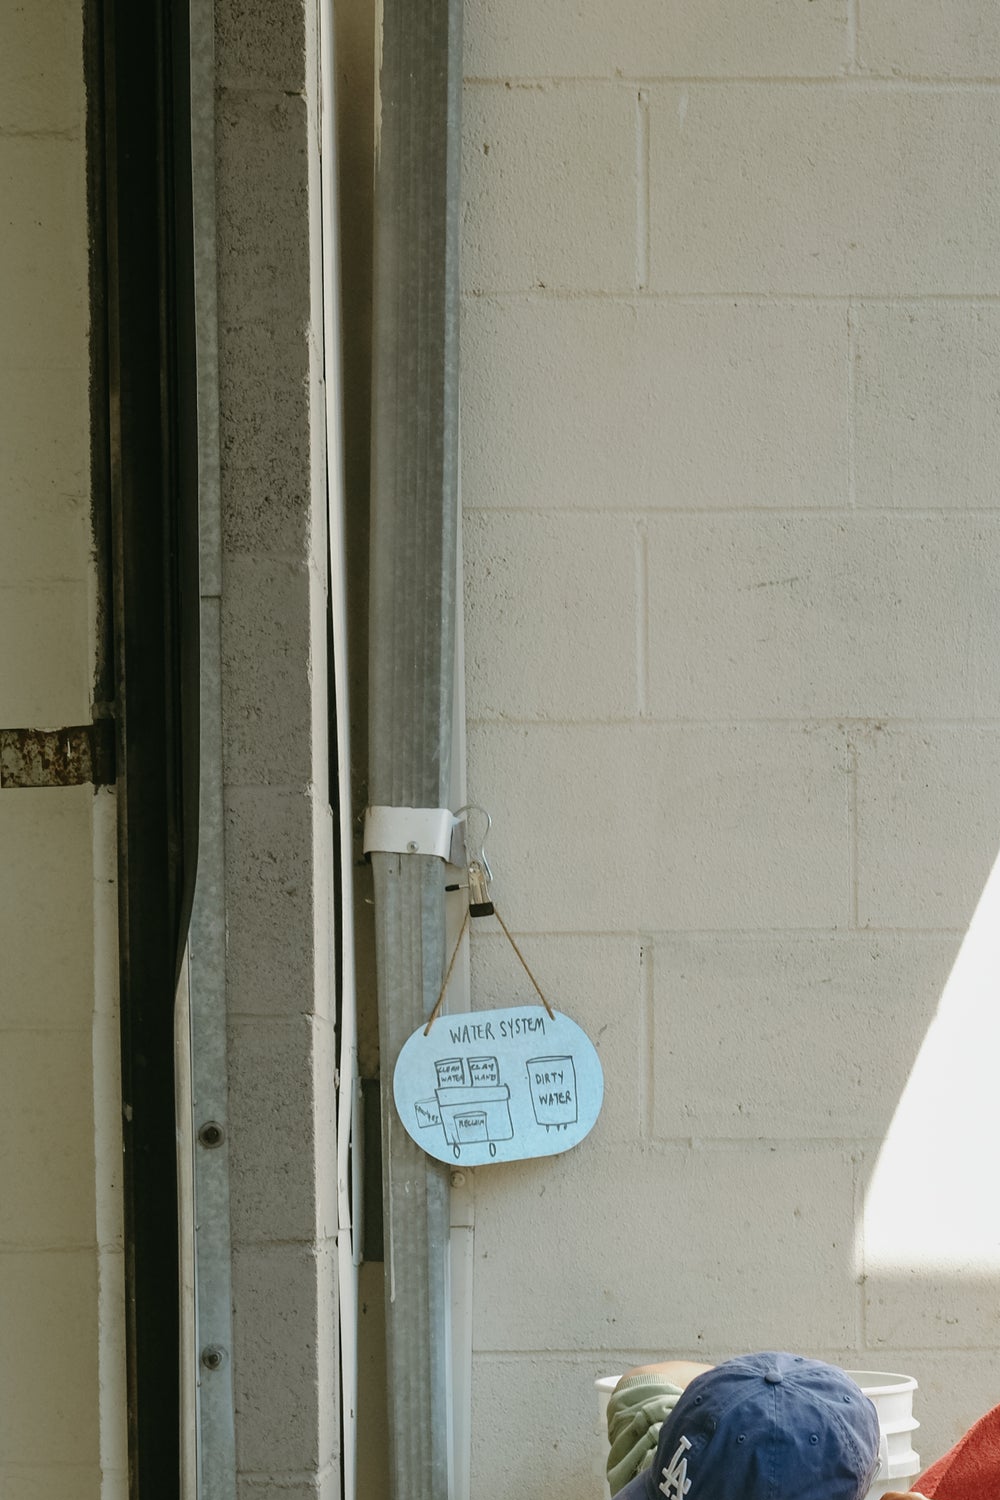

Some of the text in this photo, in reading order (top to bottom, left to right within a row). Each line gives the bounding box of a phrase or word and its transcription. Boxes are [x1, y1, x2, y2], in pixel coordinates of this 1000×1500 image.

[450, 1017, 545, 1044] WATER SYSTEM
[471, 1063, 494, 1071] CLAY
[536, 1071, 564, 1085] DIRTY
[539, 1090, 572, 1105] WATER
